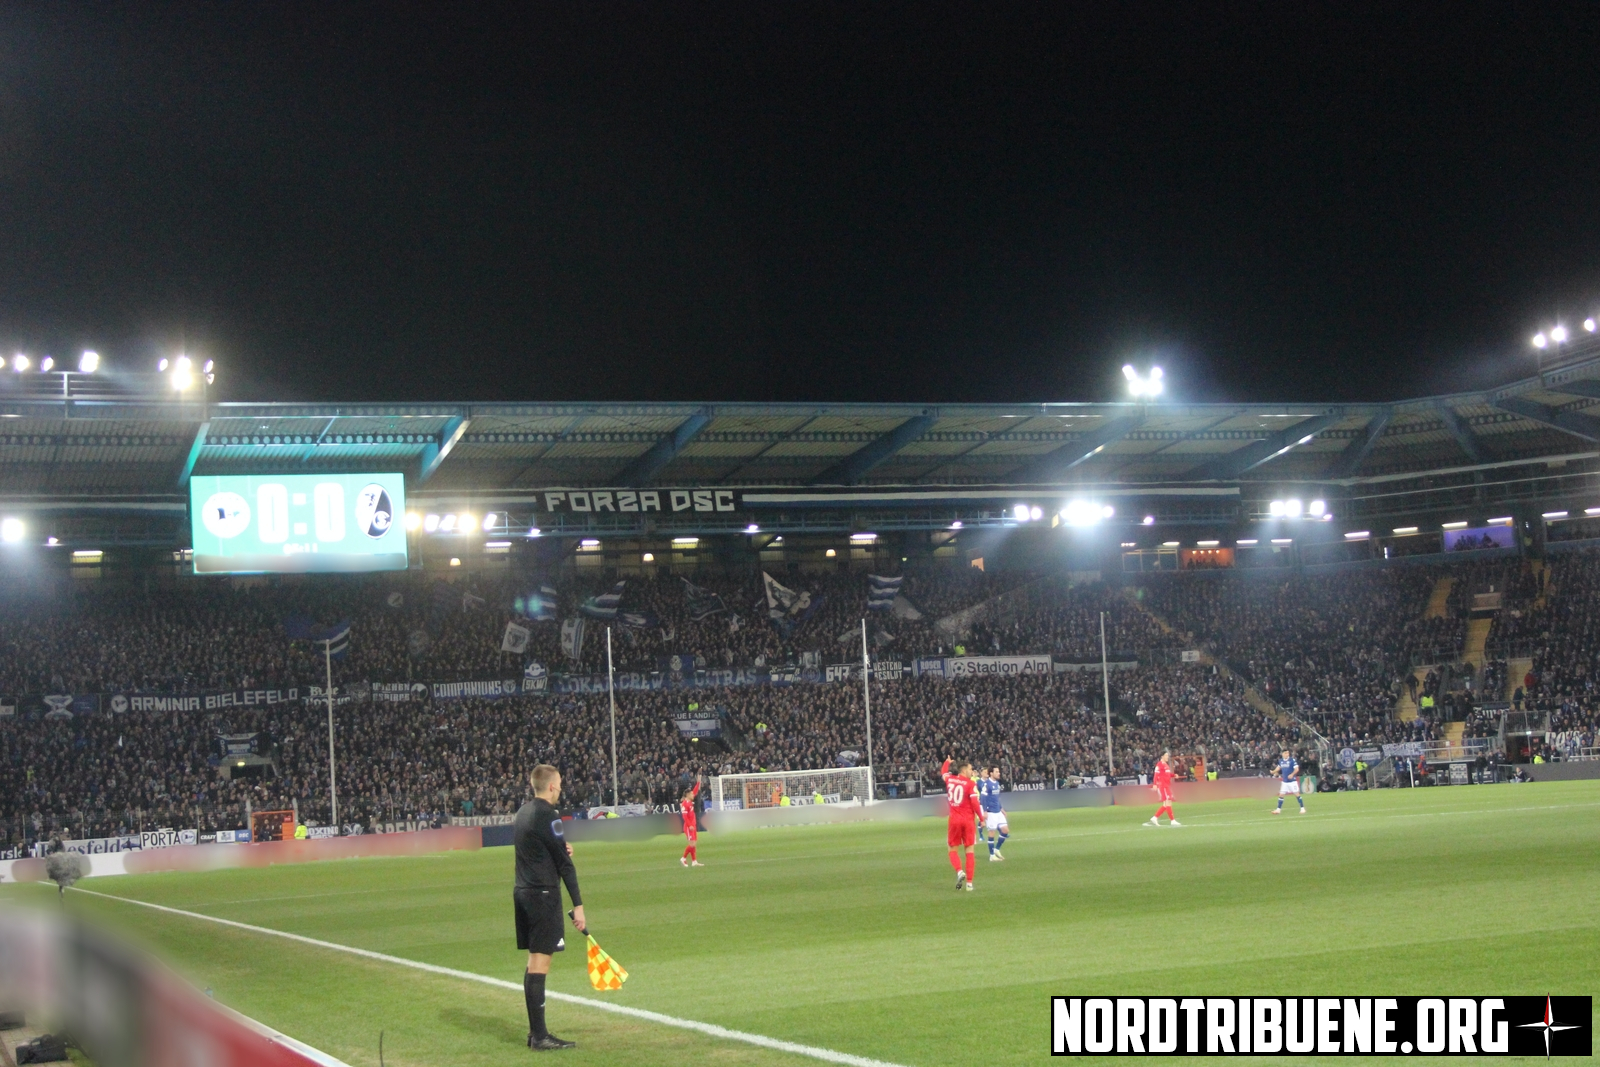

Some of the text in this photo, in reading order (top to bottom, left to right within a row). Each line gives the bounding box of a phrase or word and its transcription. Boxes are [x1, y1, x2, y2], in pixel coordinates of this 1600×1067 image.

[545, 491, 735, 512] FORZA DSC
[967, 660, 1049, 674] Stadion Alm
[433, 681, 502, 698] COMPANIONS
[131, 696, 200, 711] ARMINIA
[205, 688, 298, 709] BIELEFELD
[947, 784, 964, 804] 30
[1012, 782, 1045, 792] AGILUS
[790, 796, 838, 806] SAMON
[452, 814, 517, 827] FETTKATZEN
[142, 832, 180, 847] PORTA
